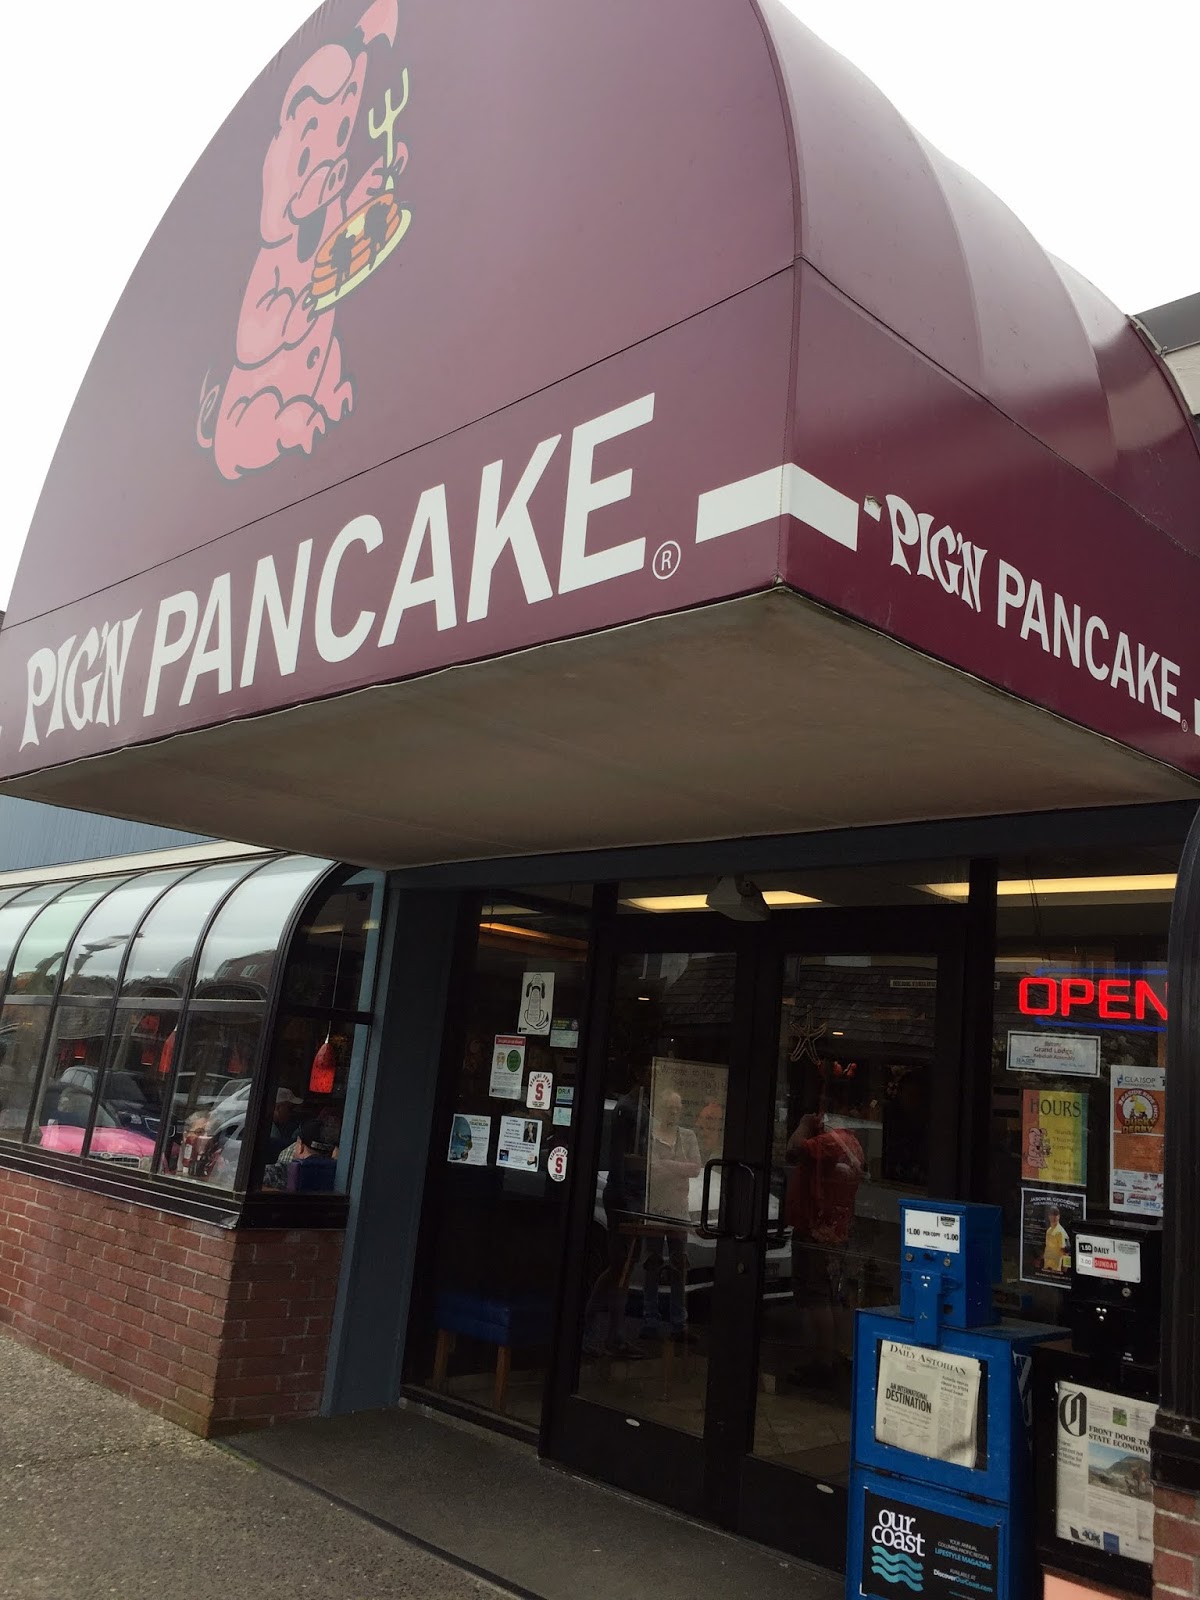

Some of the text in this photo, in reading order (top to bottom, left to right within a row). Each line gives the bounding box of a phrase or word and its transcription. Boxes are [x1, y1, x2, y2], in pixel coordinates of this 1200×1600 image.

[143, 392, 656, 718] PANCAKE
[997, 558, 1181, 723] PANCAKE
[1018, 977, 1168, 1021] OPEN
[1125, 1076, 1156, 1084] CLATSOP
[1031, 1099, 1081, 1118] HOURS
[1094, 1246, 1110, 1255] DAILY
[1095, 1259, 1117, 1271] SUNDAY
[890, 1344, 966, 1376] DAILY ASTORIAN
[886, 1388, 932, 1414] DESTINATION
[1088, 1433, 1149, 1455] STATE ECONOMY
[1089, 1425, 1113, 1437] FRONT
[1115, 1432, 1136, 1443] DOOR
[878, 1509, 916, 1535] our
[871, 1525, 926, 1557] coast
[934, 1548, 993, 1570] LIFESTYLE MAGAZINE
